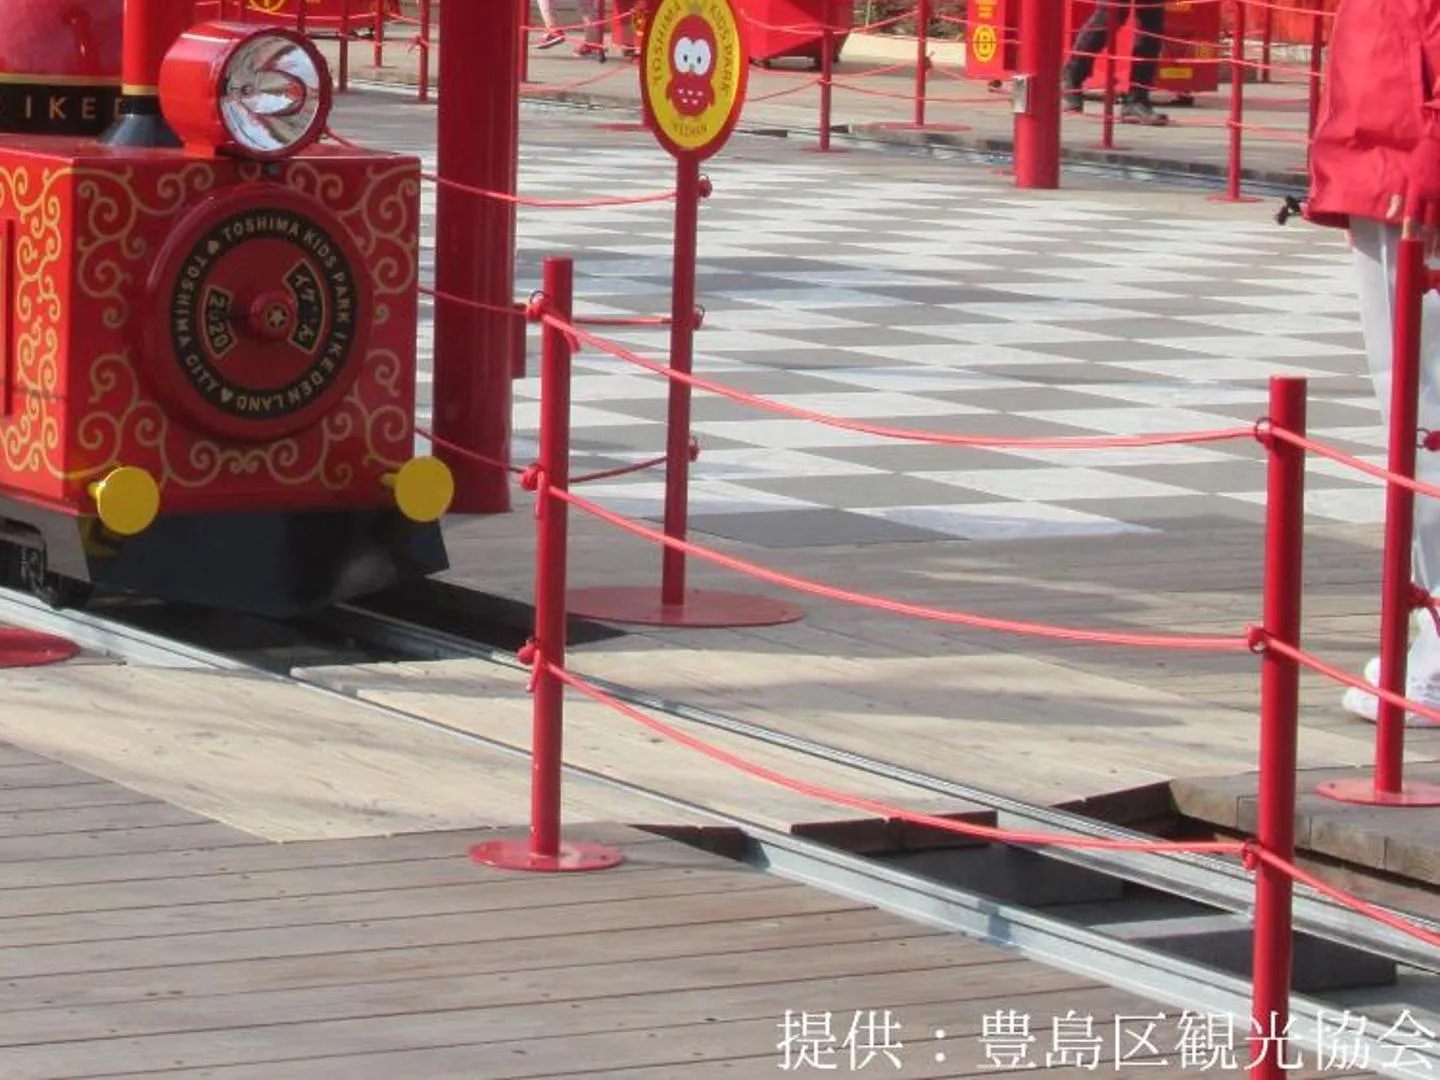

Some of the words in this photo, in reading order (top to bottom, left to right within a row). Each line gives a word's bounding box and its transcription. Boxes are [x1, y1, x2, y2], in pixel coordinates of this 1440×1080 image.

[174, 254, 208, 348] TOSHIMA
[222, 216, 299, 243] TOSHIMA
[303, 232, 338, 269] KIDS
[331, 271, 351, 323] PARK
[184, 353, 221, 392] CITY
